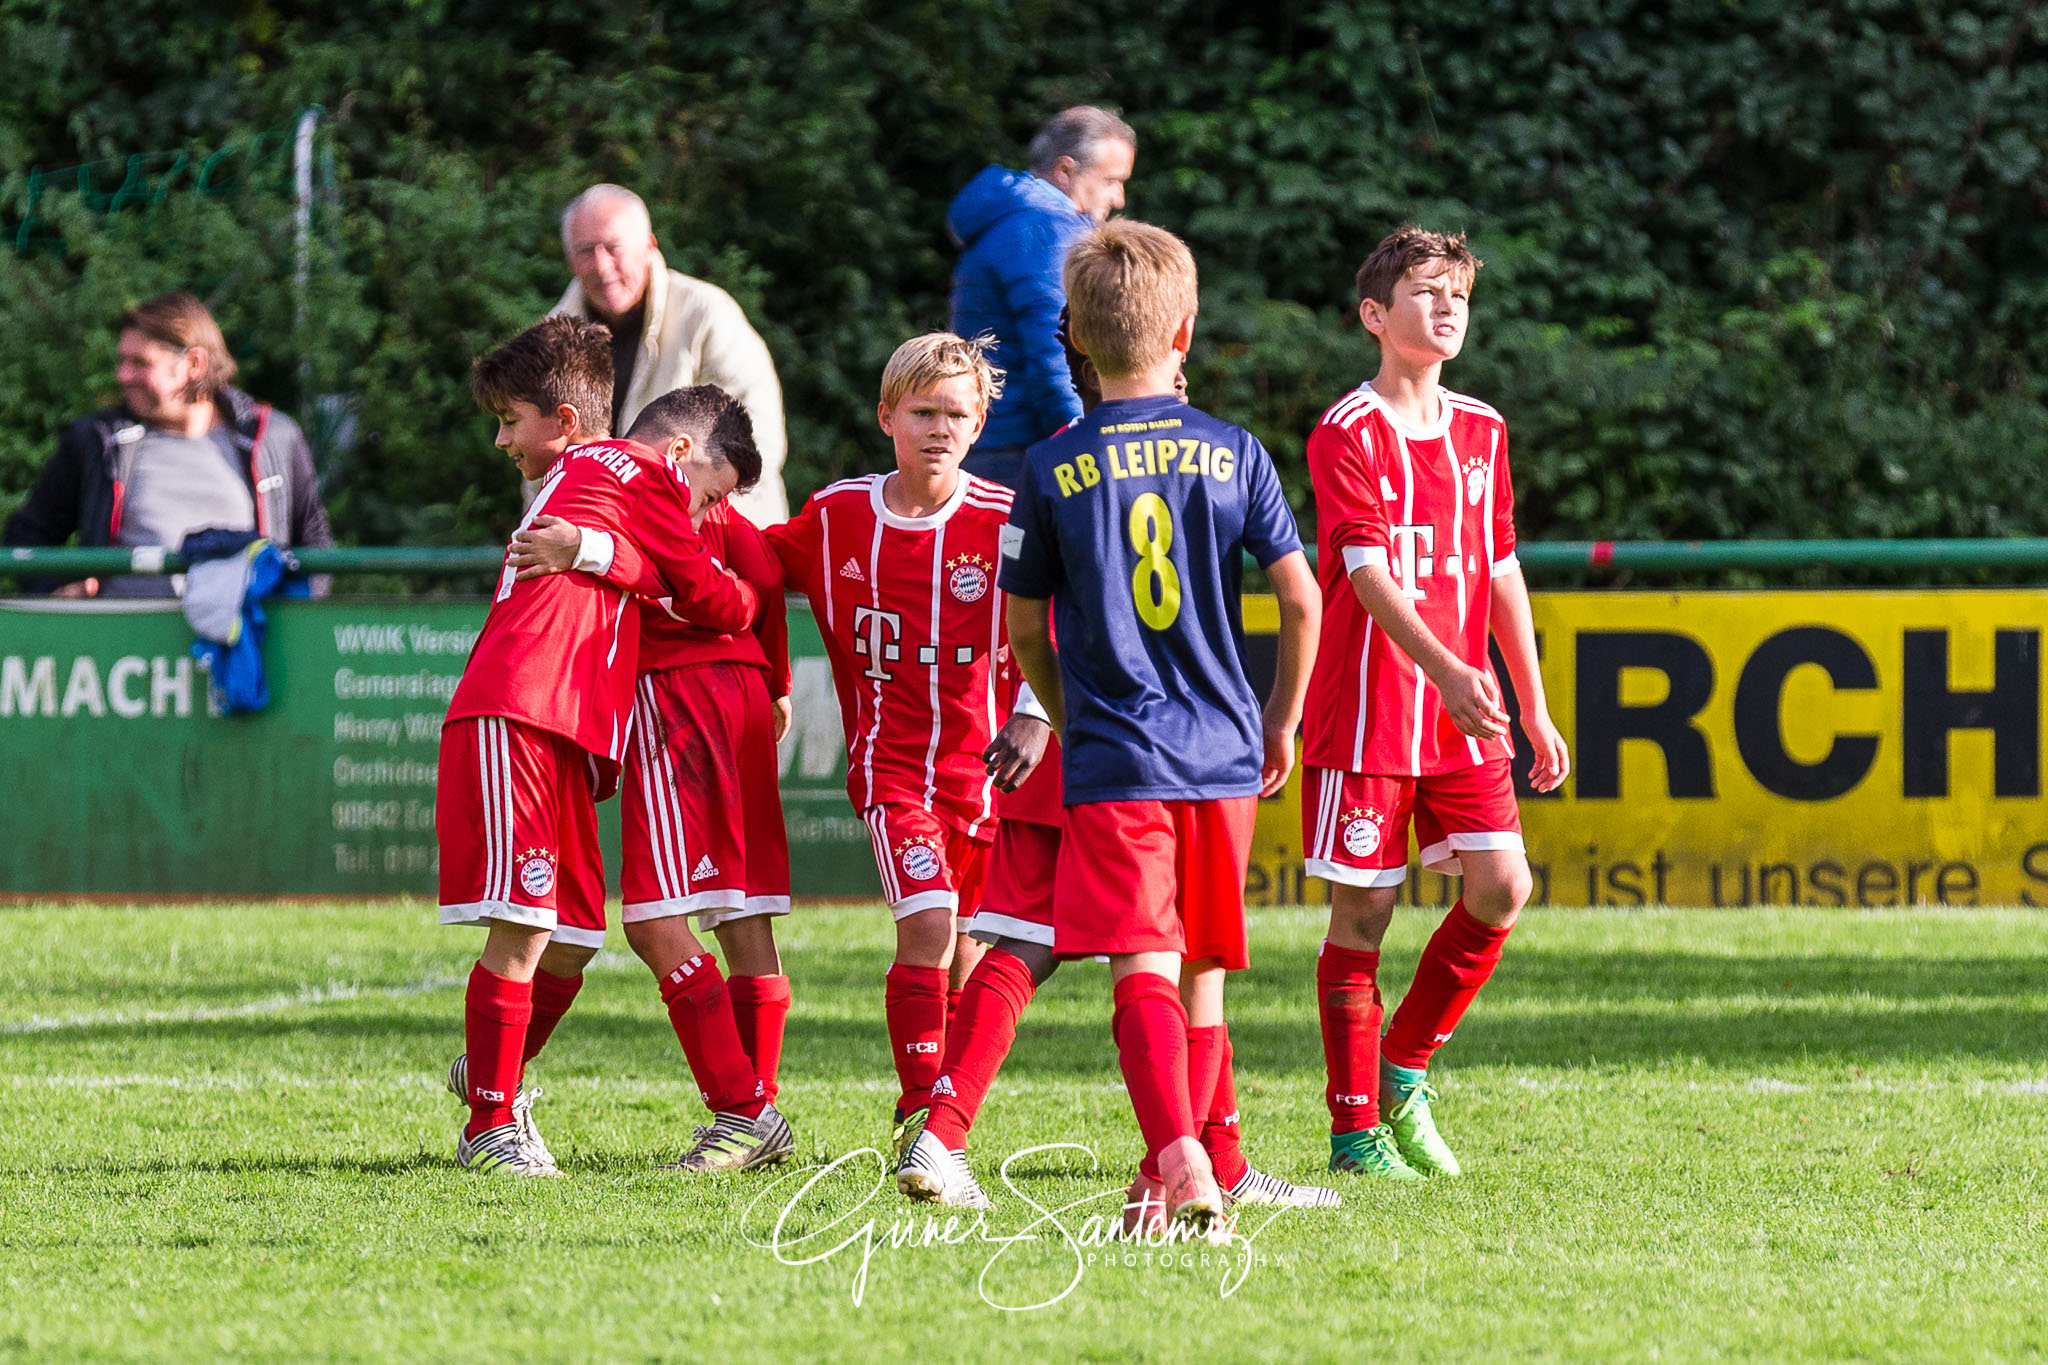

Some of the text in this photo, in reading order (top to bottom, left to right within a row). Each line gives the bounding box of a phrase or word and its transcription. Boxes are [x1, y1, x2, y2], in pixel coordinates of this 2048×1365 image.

[1100, 418, 1183, 434] DIE ROTEN BULLEN
[1054, 438, 1235, 498] RB LEIPZIG
[1129, 491, 1182, 631] 8
[333, 624, 406, 655] WWK
[690, 867, 720, 882] adidas
[1588, 848, 1668, 906] ist
[1711, 862, 1979, 907] unsere
[907, 1041, 938, 1054] FCB
[476, 1086, 505, 1102] FCB
[1335, 1093, 1369, 1106] FCB
